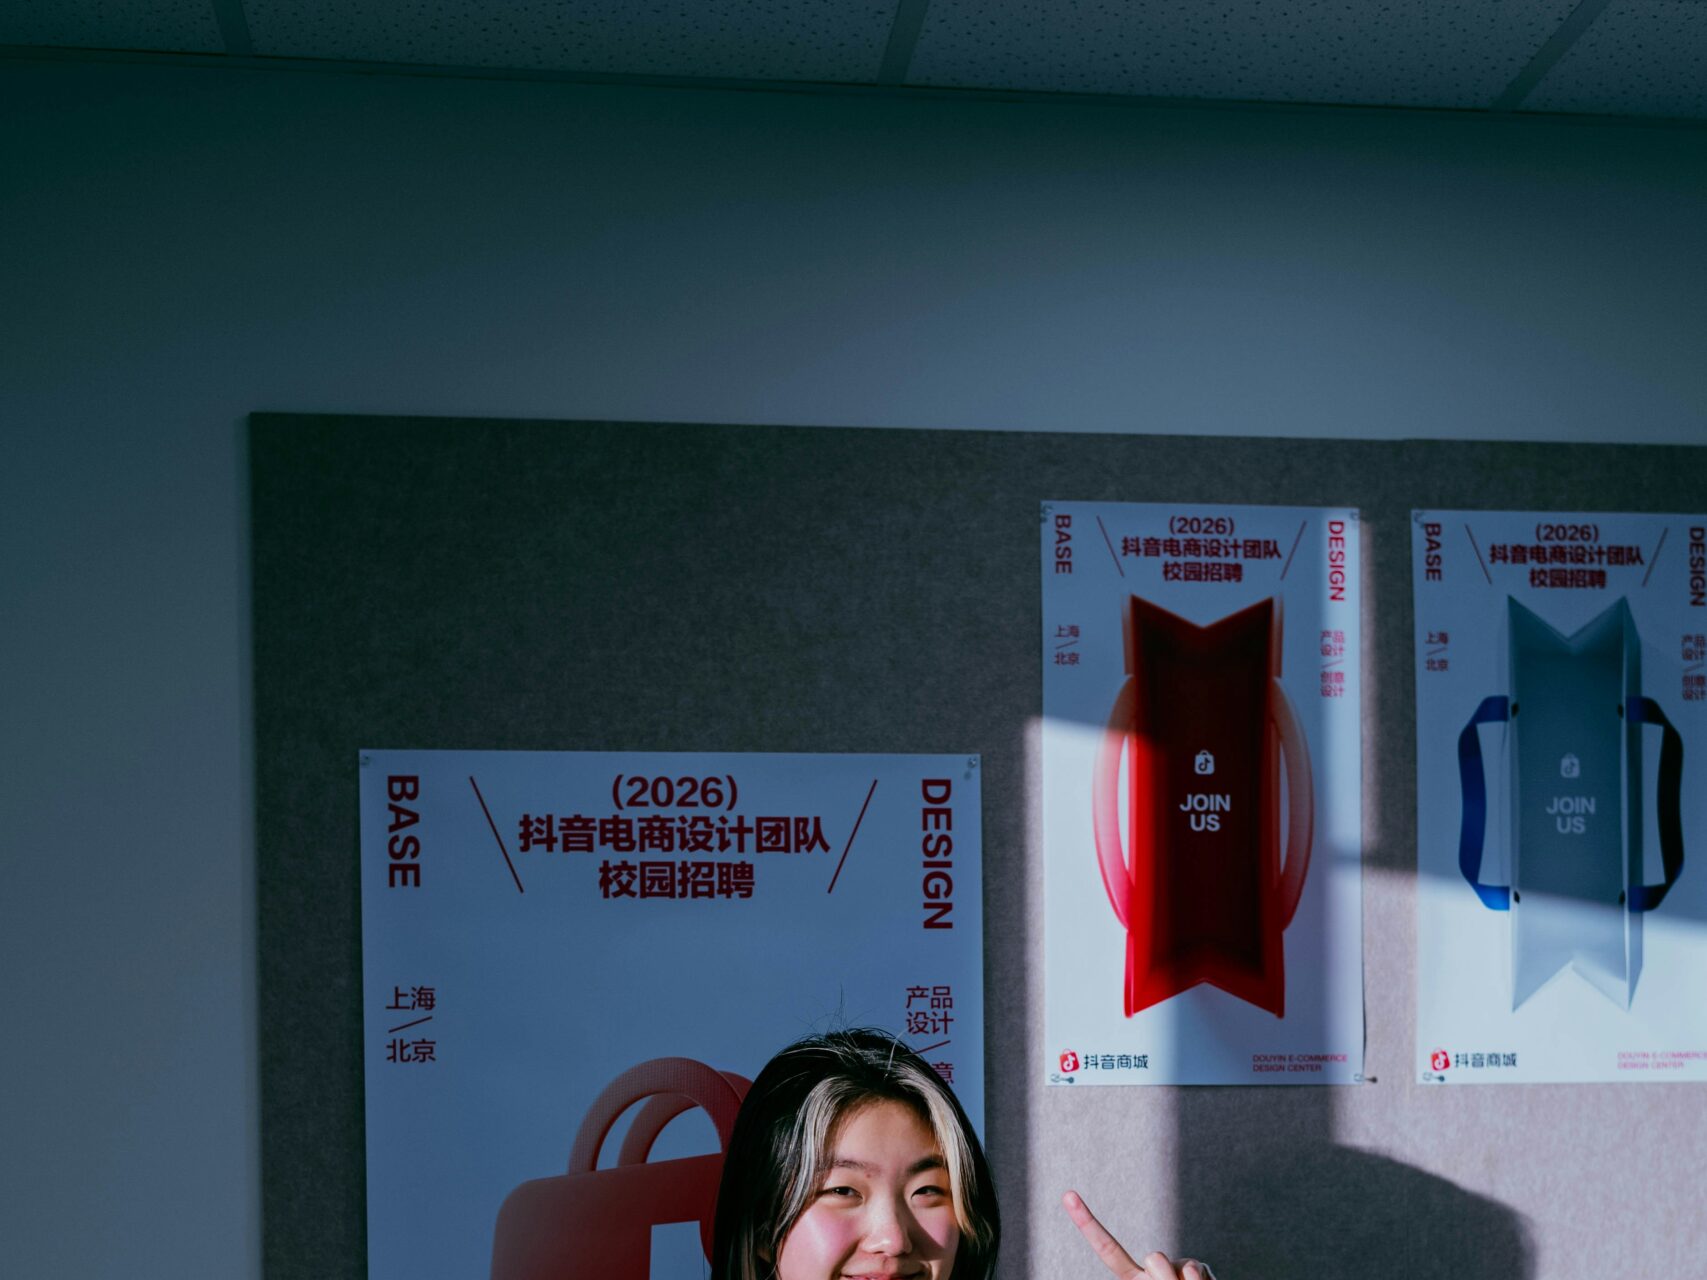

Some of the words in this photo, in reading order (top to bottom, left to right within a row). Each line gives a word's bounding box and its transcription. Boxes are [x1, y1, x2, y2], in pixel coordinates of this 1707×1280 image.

[1169, 516, 1235, 536] (2026)
[1535, 523, 1600, 543] (2026)
[1055, 514, 1072, 574] BASE
[1121, 537, 1282, 560] 抖音电商设计团队
[1425, 522, 1442, 581] BASE
[1489, 544, 1645, 566] 抖音电商设计团队
[1162, 562, 1243, 583] 校园招聘
[1328, 520, 1345, 602] DESIGN
[1690, 527, 1706, 607] DESIGN
[1529, 568, 1607, 589] 校园招聘
[1054, 652, 1080, 666] 北京
[611, 774, 738, 812] (2026)
[1179, 794, 1231, 812] JOIN
[1545, 796, 1596, 814] JOIN
[387, 775, 421, 889] BASE
[518, 814, 831, 855] 抖音电商设计团队
[1190, 814, 1221, 832] US
[1556, 816, 1586, 834] US
[922, 778, 954, 930] DESIGN
[599, 861, 755, 899] 校园招聘
[386, 986, 437, 1011] 上海
[905, 985, 954, 1009] 产品
[905, 1011, 954, 1035] 设计
[386, 1039, 437, 1064] 北京
[1083, 1054, 1149, 1071] 抖音商城
[1455, 1052, 1518, 1069] 抖音商城
[1252, 1064, 1285, 1072] DESIGN
[1287, 1064, 1322, 1072] CENTER
